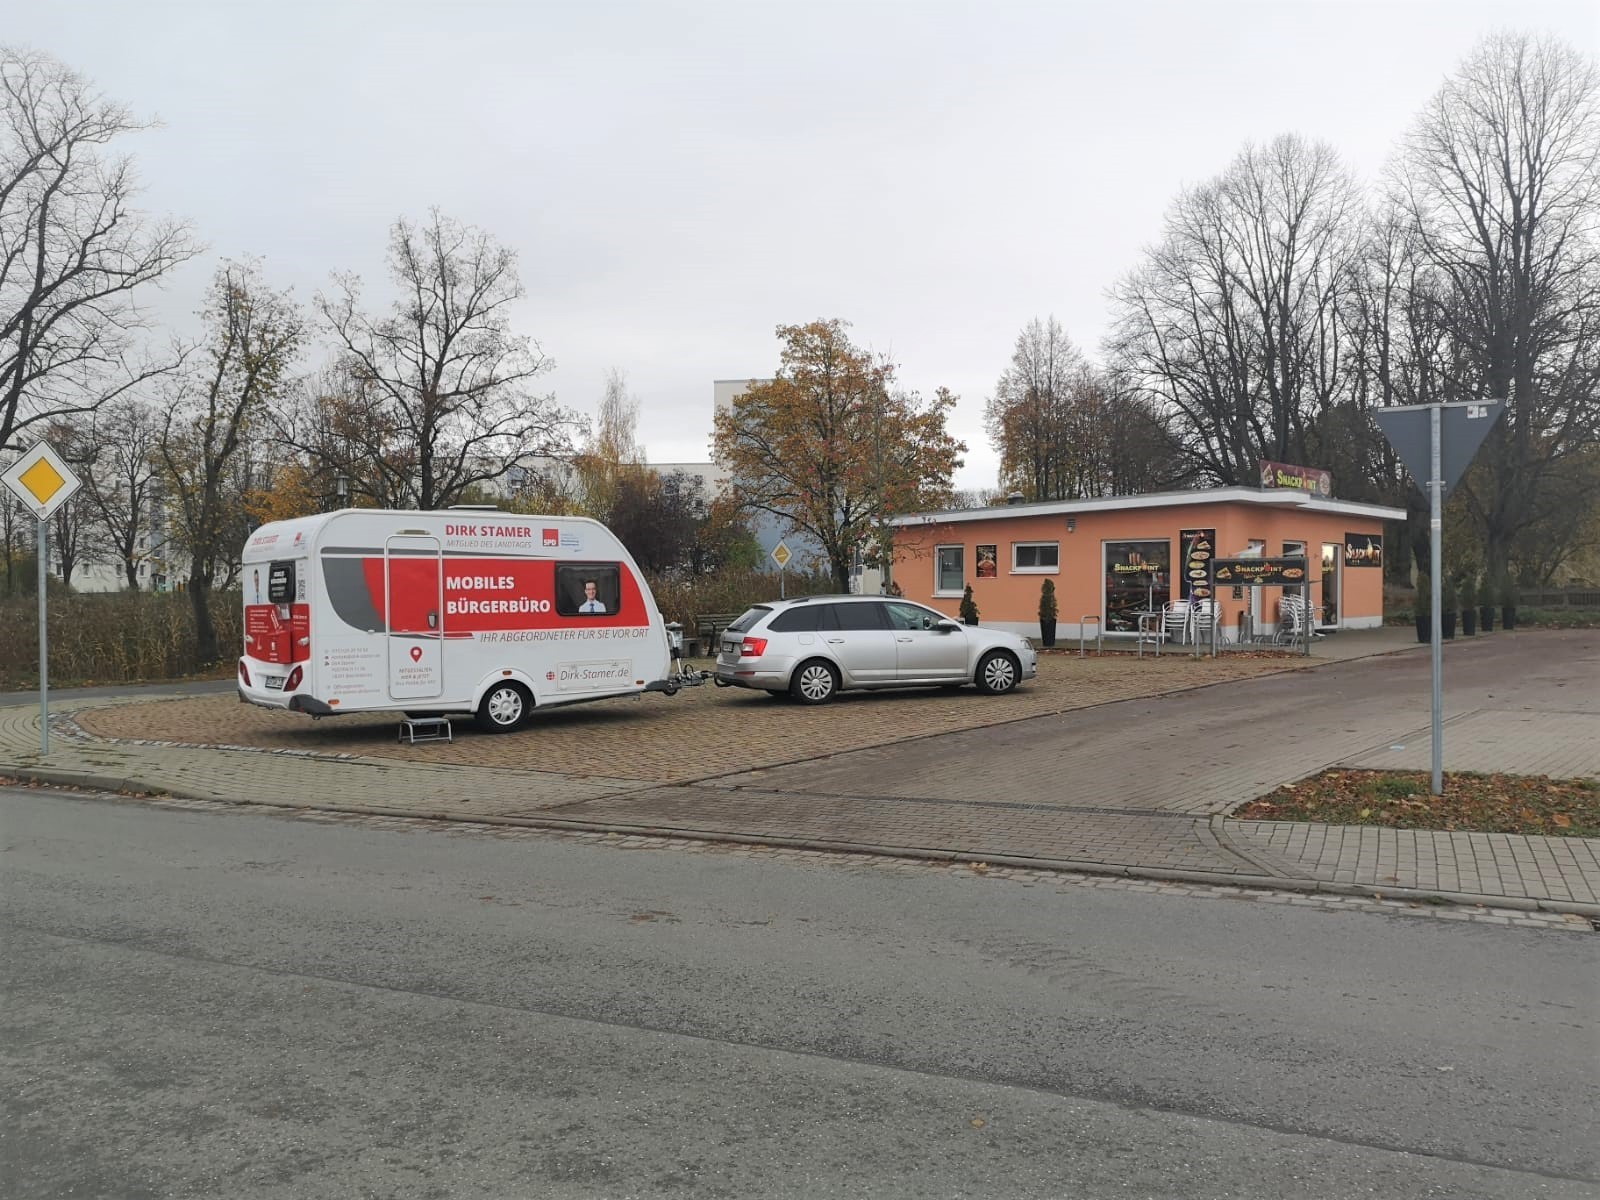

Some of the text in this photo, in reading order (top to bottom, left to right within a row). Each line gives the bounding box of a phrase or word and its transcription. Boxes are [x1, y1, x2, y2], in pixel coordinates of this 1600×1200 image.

[446, 525, 532, 537] DIRK STAMER
[447, 540, 532, 549] MITGLIED DES LANDTAGES
[446, 576, 515, 590] MOBILES
[447, 596, 551, 614] BÜRGERBÜRO
[480, 632, 498, 643] IHR
[499, 631, 575, 642] ABGEORDNETER
[597, 629, 611, 639] SIE
[612, 628, 630, 639] VOR
[632, 628, 649, 638] ORT
[560, 667, 629, 681] Dirk-Stamer.de
